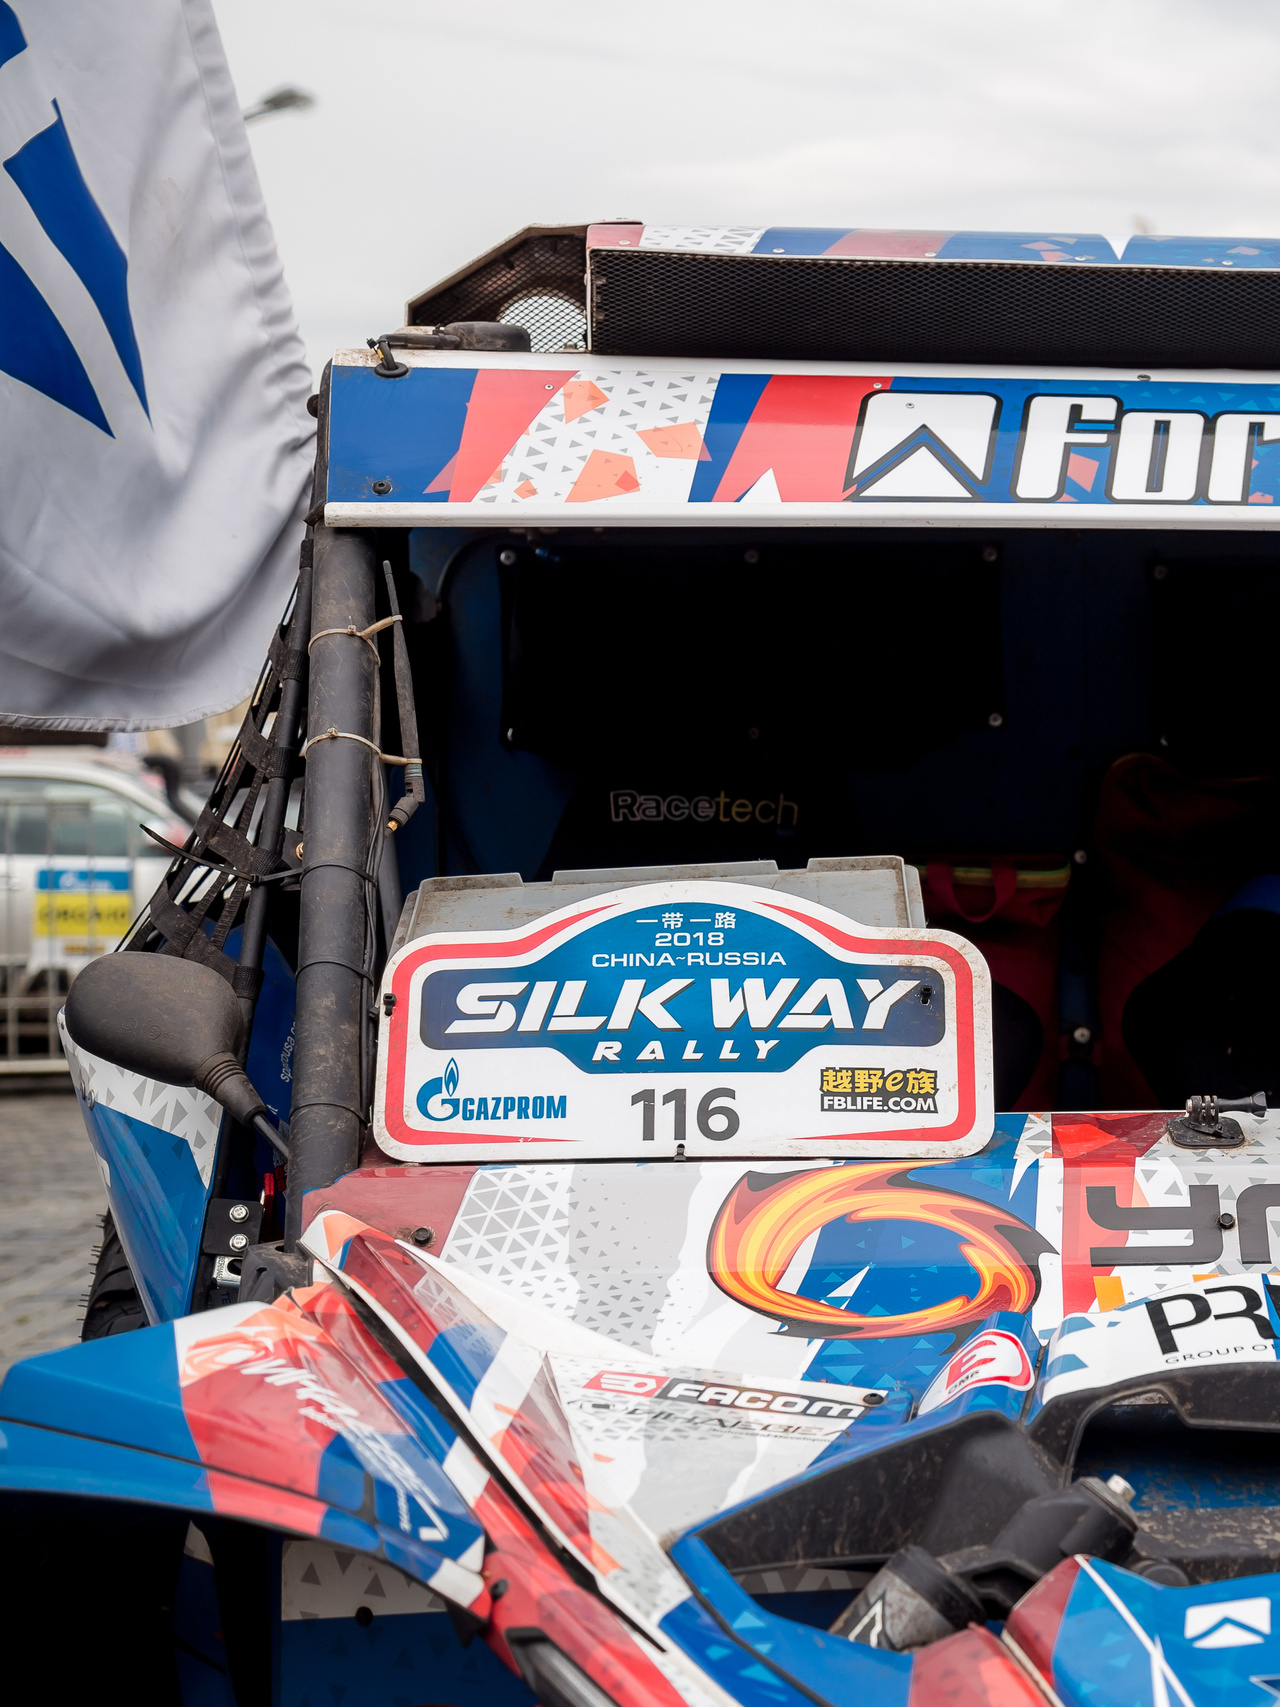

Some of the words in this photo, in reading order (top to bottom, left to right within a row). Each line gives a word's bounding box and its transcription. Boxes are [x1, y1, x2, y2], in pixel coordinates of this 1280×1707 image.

[609, 789, 800, 828] Racetech
[637, 911, 737, 930] 一带一路
[654, 932, 724, 947] 2018
[444, 977, 696, 1035] SILK
[710, 977, 922, 1031] WAY
[591, 1039, 782, 1062] RALLY
[822, 1069, 936, 1095] 越野e族
[461, 1094, 568, 1122] GAZPROM
[630, 1088, 741, 1142] 116
[823, 1096, 936, 1111] FBLIFE.COM
[1165, 1345, 1245, 1365] GROUP
[1251, 1342, 1280, 1353] OF
[667, 1382, 866, 1419] FACOM
